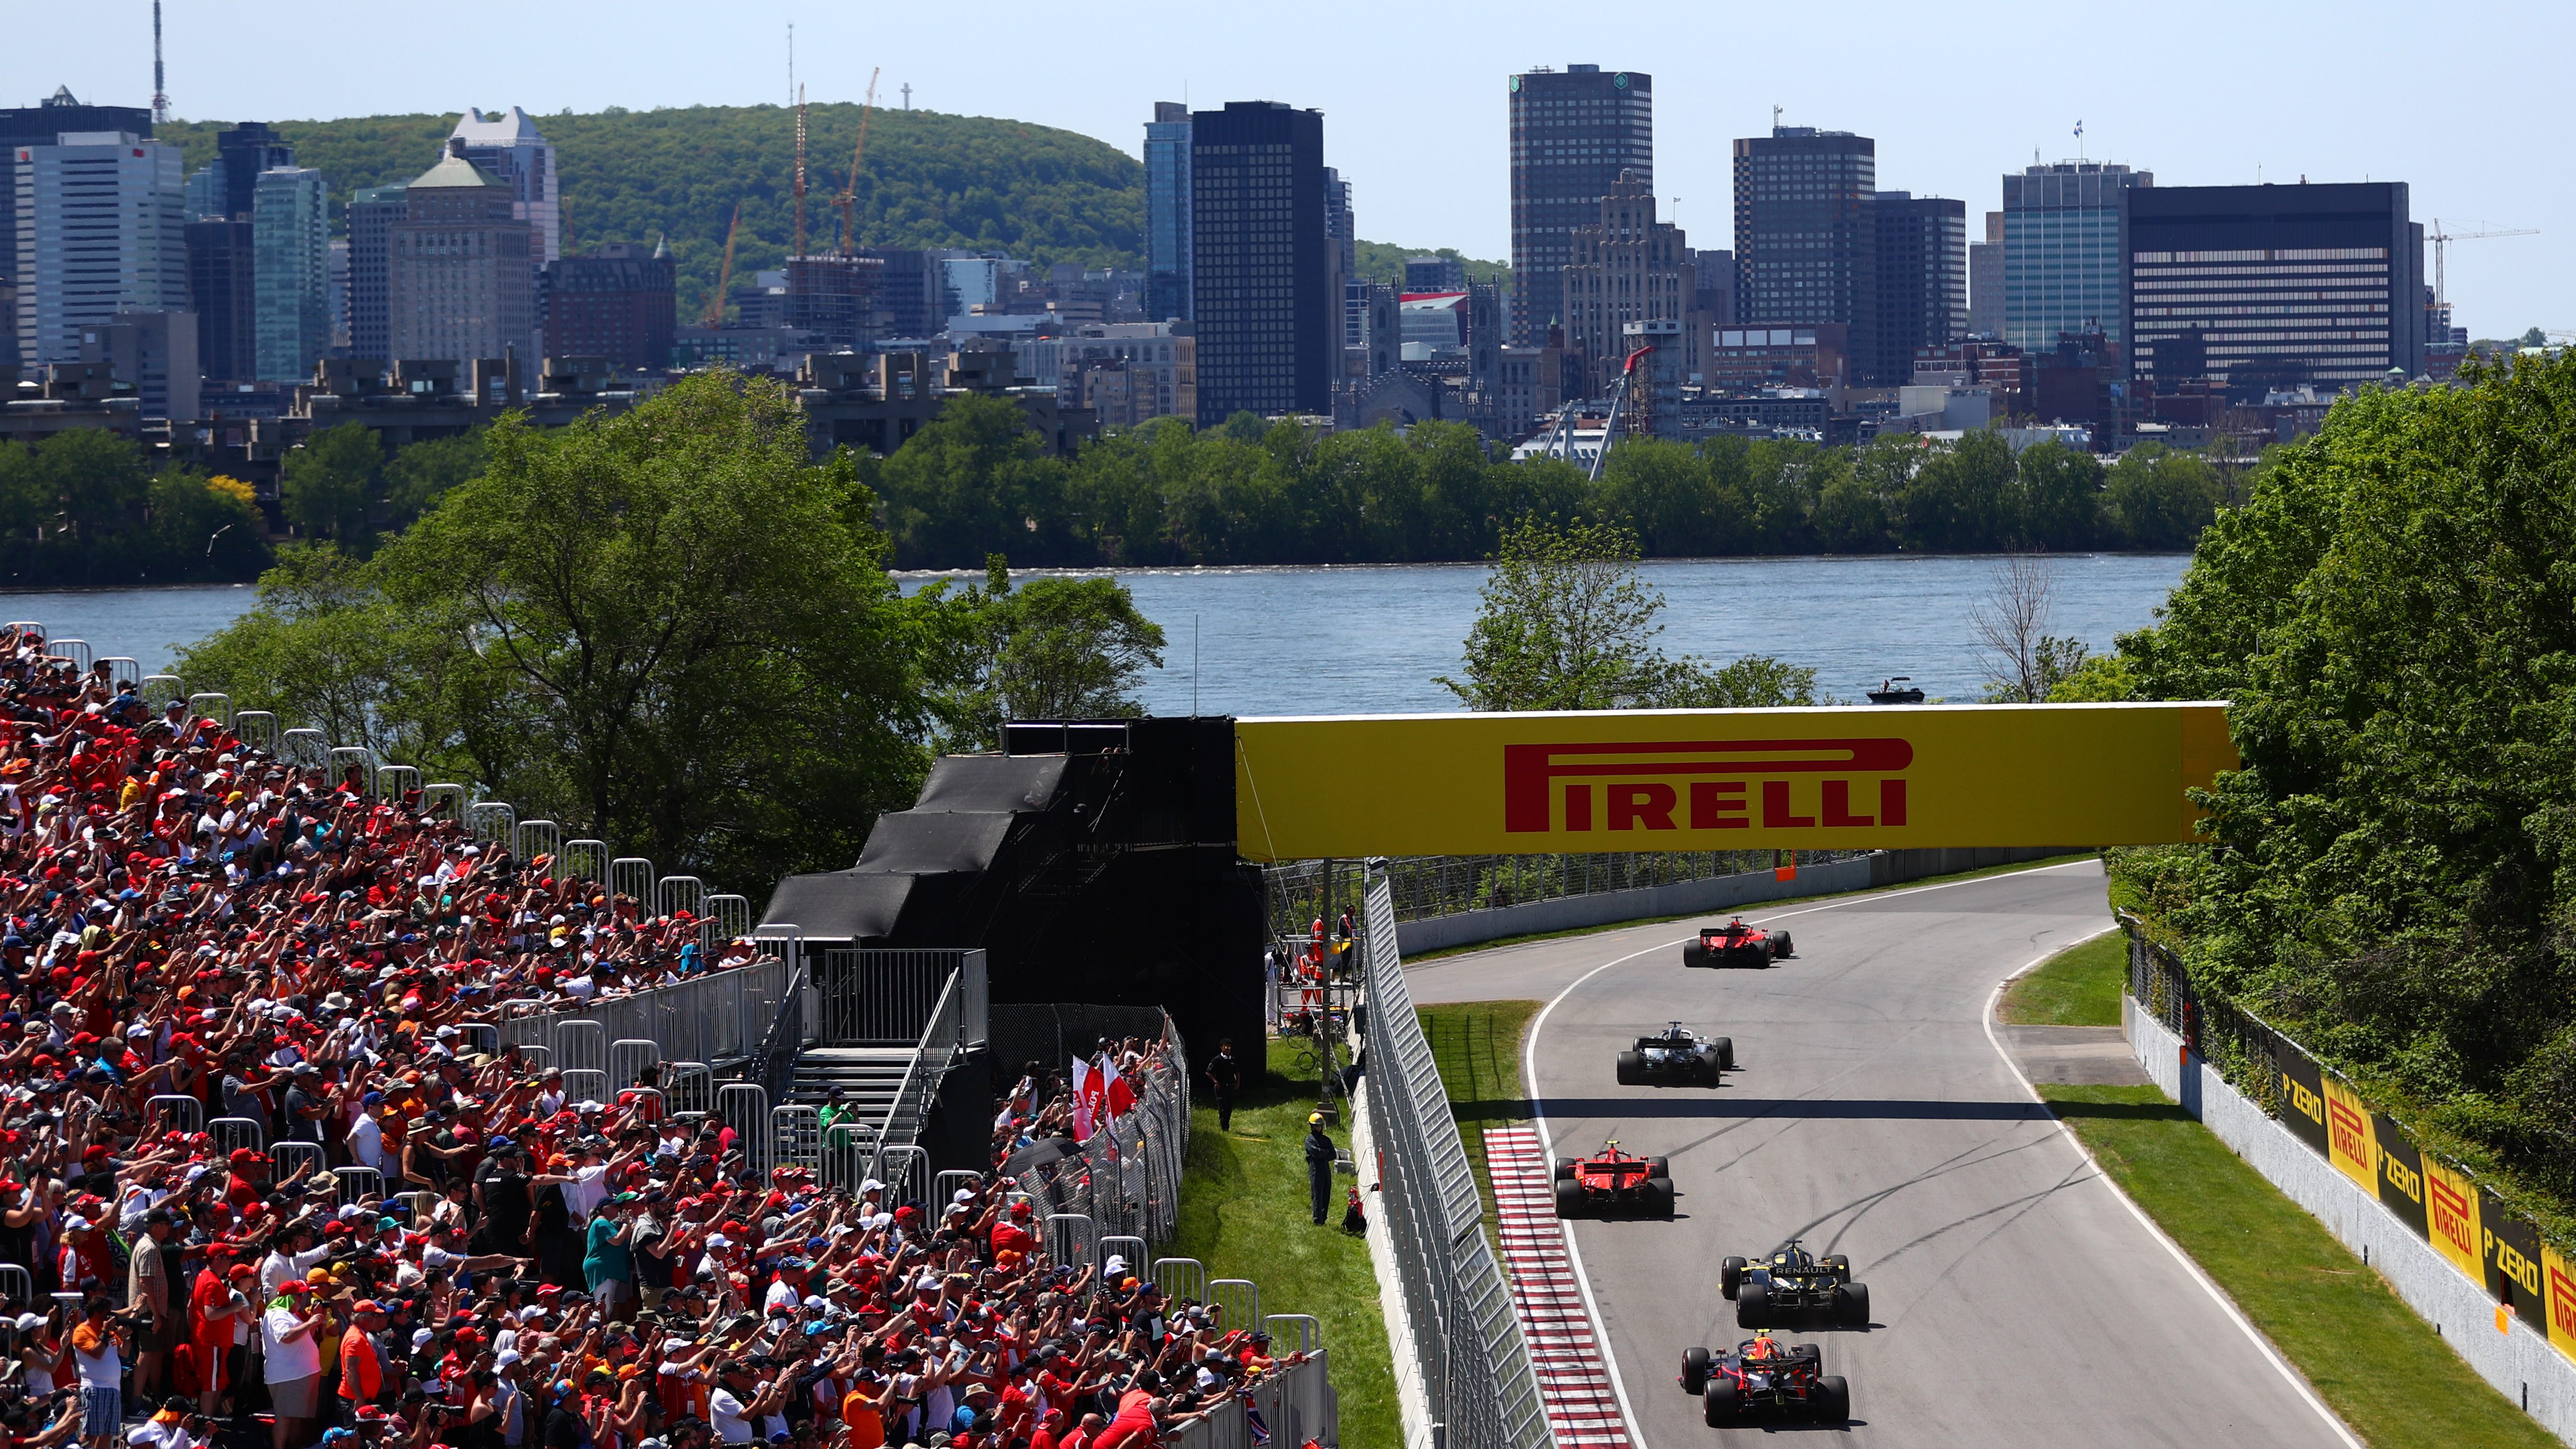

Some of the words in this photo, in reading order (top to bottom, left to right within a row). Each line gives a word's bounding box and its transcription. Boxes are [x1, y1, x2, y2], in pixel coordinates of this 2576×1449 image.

[1504, 737, 1914, 832] PIRELLI
[2283, 1072, 2290, 1099] P
[2292, 1079, 2322, 1125] ZERO
[2328, 1096, 2368, 1171] PIRELLI
[2377, 1141, 2383, 1170] P
[2385, 1150, 2420, 1204] ZERO
[2429, 1174, 2473, 1257] PIRELLI
[2484, 1227, 2493, 1258] P
[2496, 1236, 2538, 1297] ZERO
[2550, 1265, 2576, 1341] PIR
